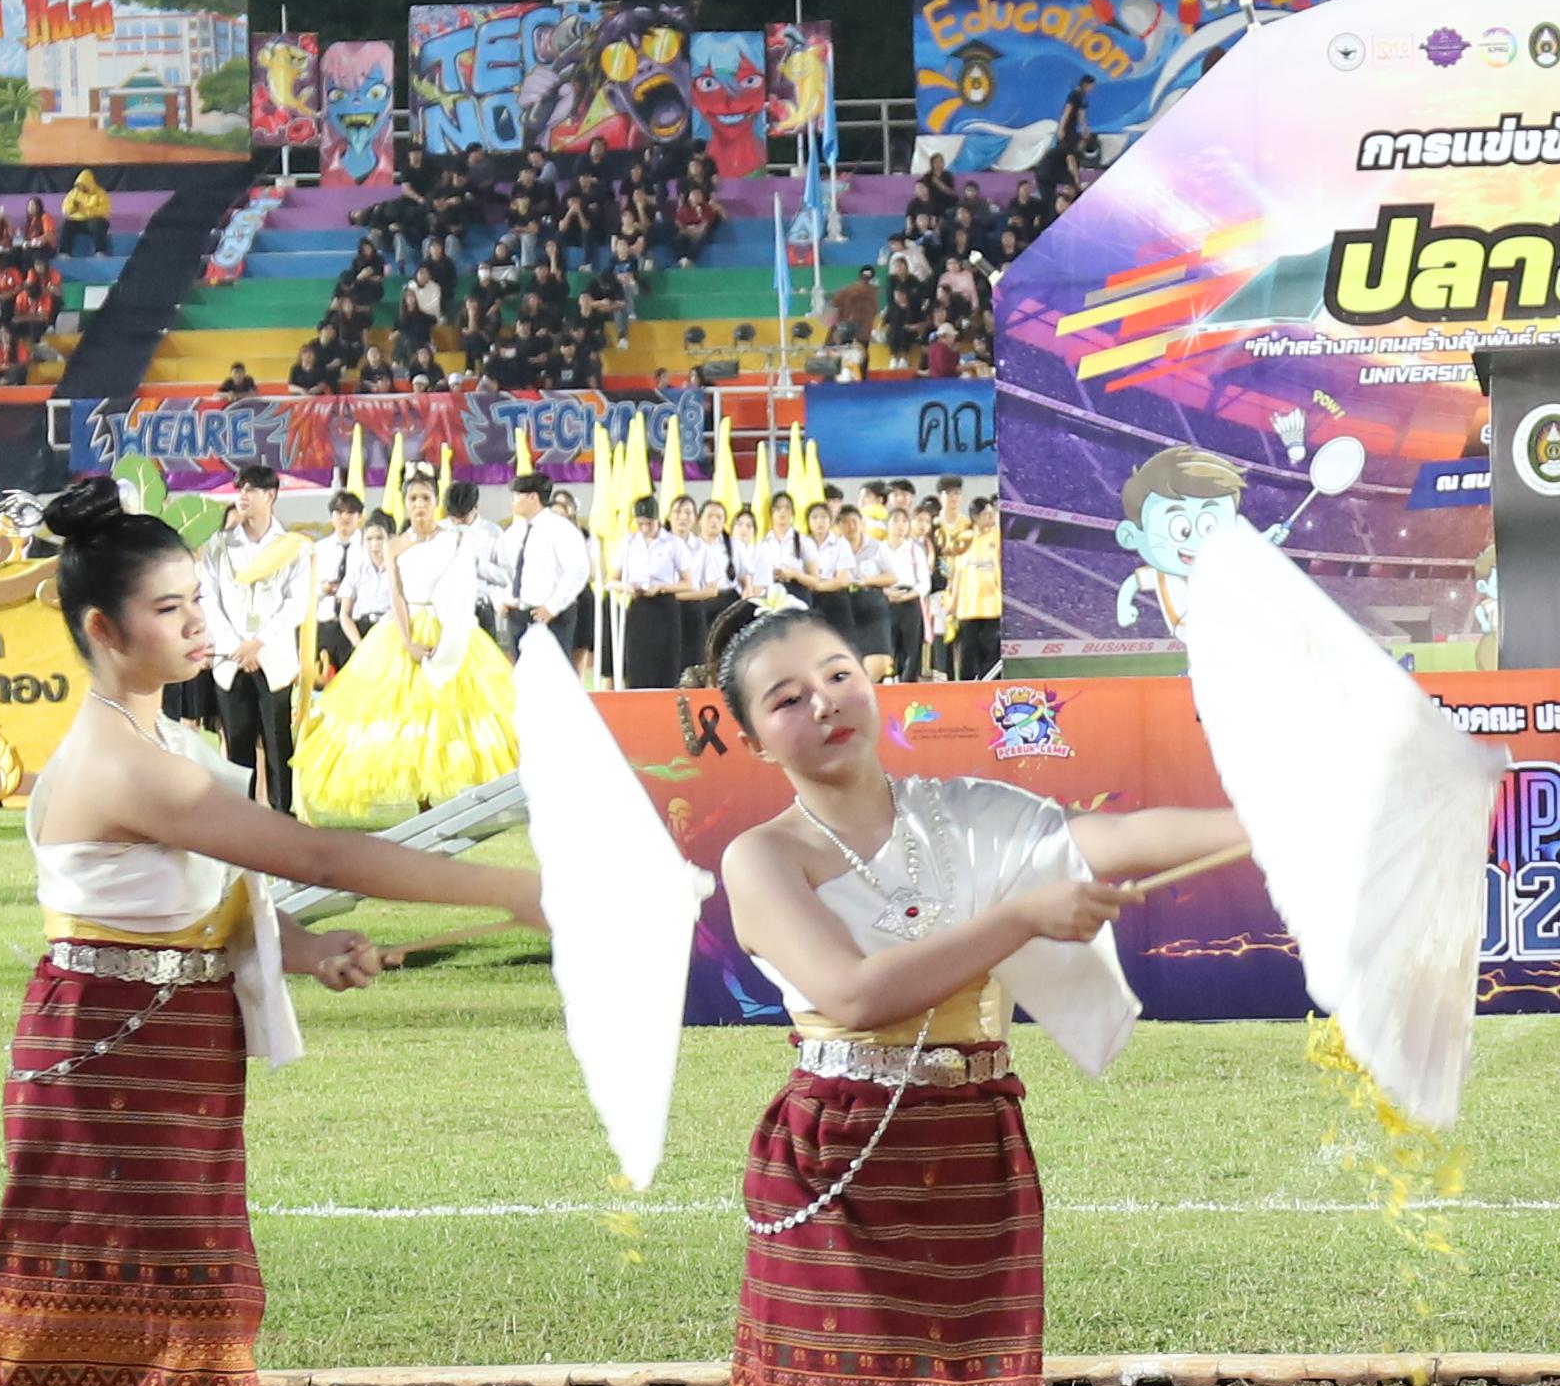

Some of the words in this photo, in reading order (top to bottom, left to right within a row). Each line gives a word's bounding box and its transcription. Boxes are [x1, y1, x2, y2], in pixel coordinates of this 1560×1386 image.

[419, 2, 603, 94] TEC
[423, 91, 524, 155] NO
[1070, 514, 1118, 529] BUSINES
[1081, 641, 1155, 654] BUSINESS
